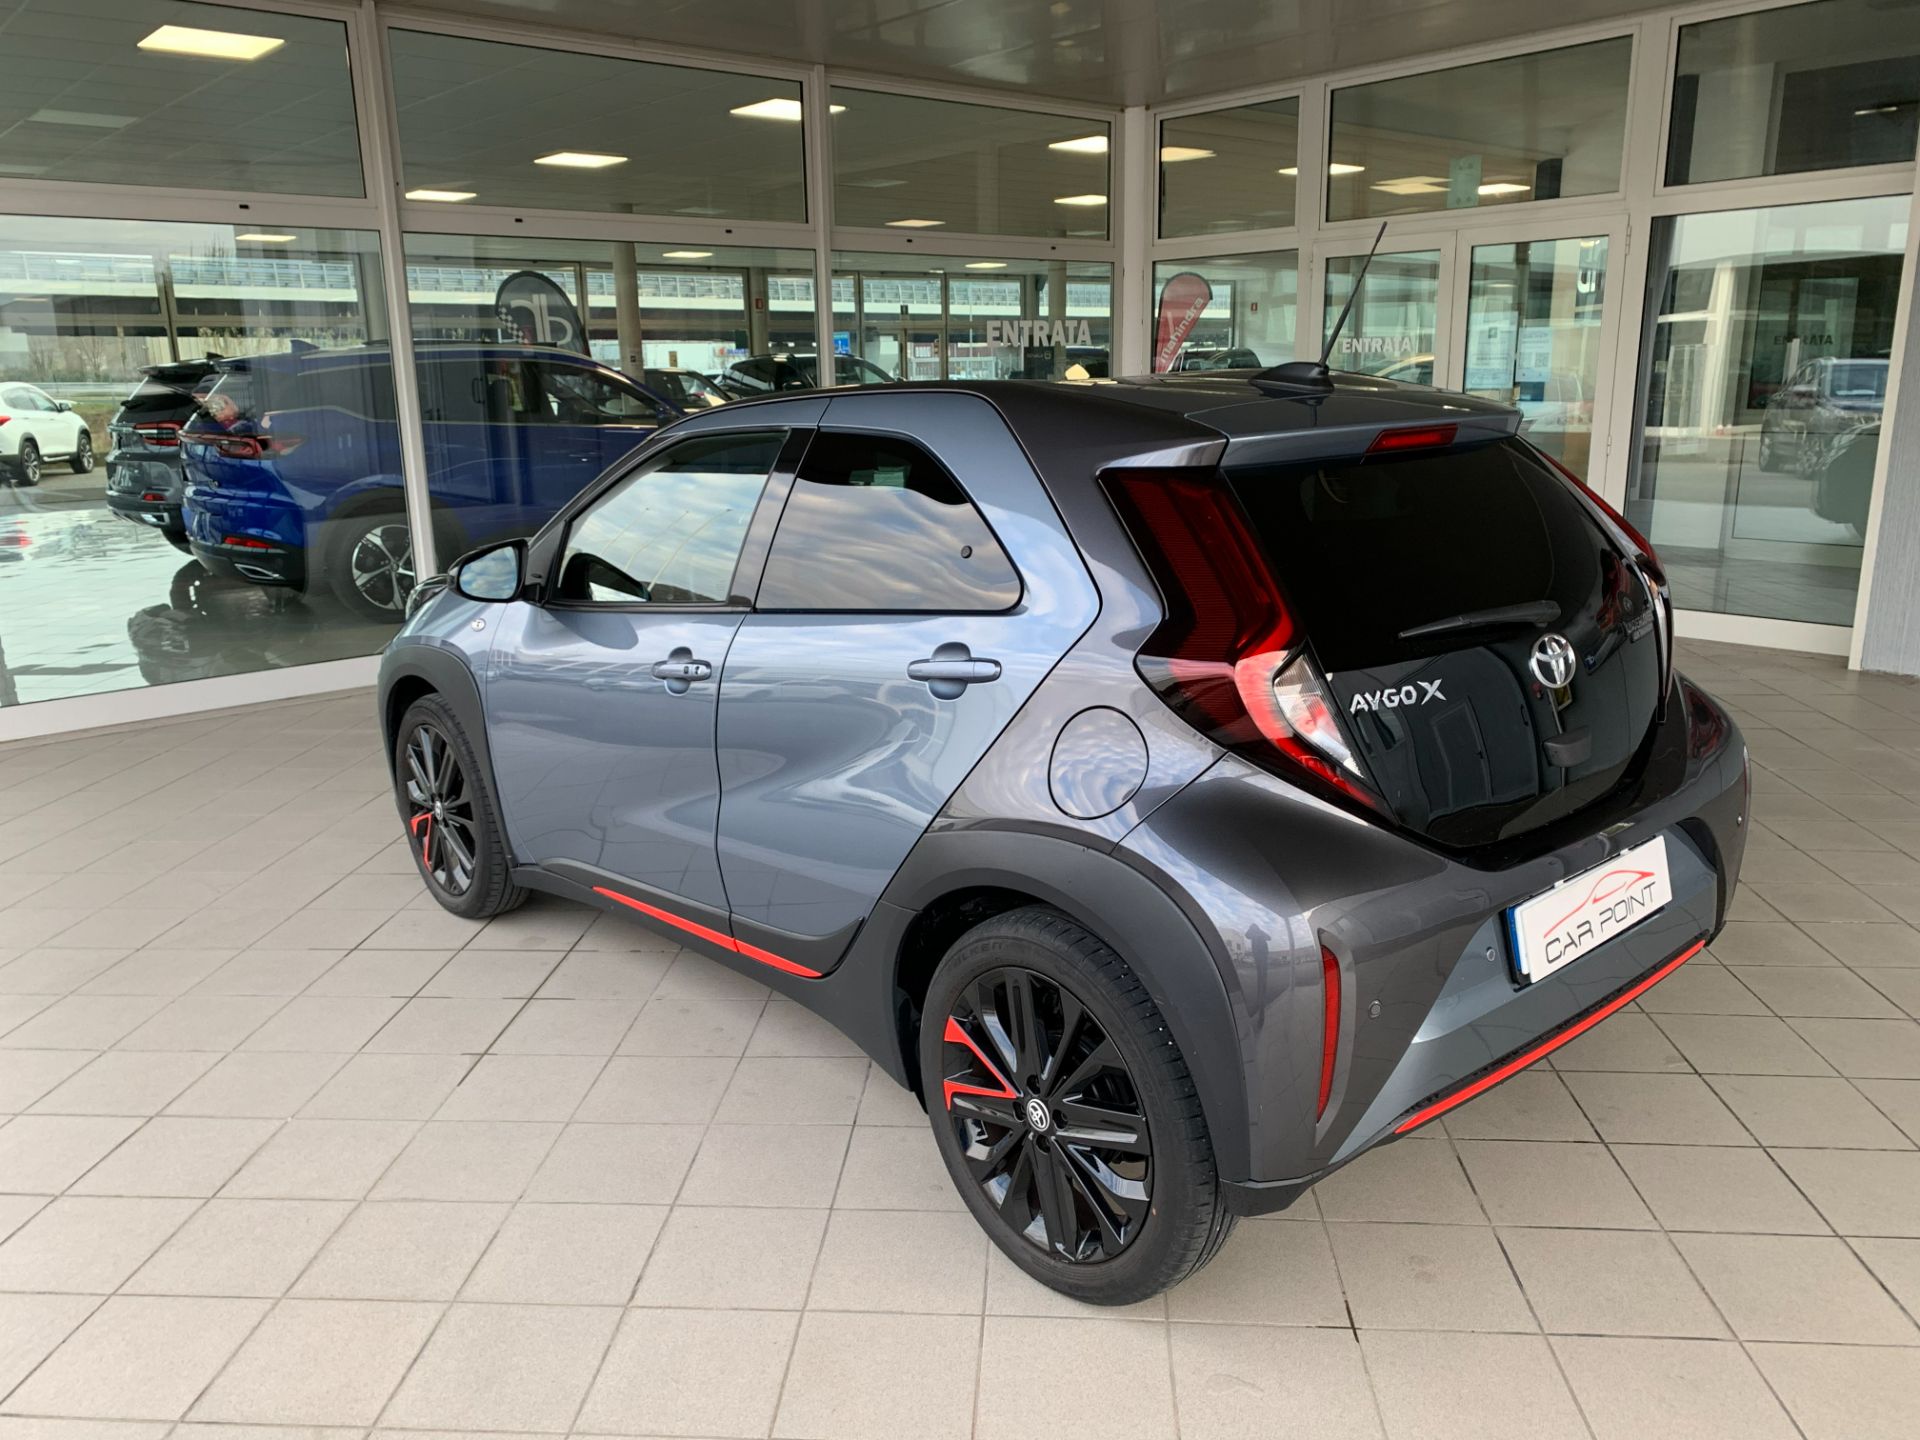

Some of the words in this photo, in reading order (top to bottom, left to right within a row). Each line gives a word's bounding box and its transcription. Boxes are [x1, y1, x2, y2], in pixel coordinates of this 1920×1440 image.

[986, 319, 1092, 348] ENTRATA
[1342, 336, 1411, 353] ENTRATA
[1350, 685, 1417, 714] AYGO
[1416, 679, 1447, 705] X
[1545, 919, 1595, 965] CAR
[1599, 881, 1656, 934] POINT
